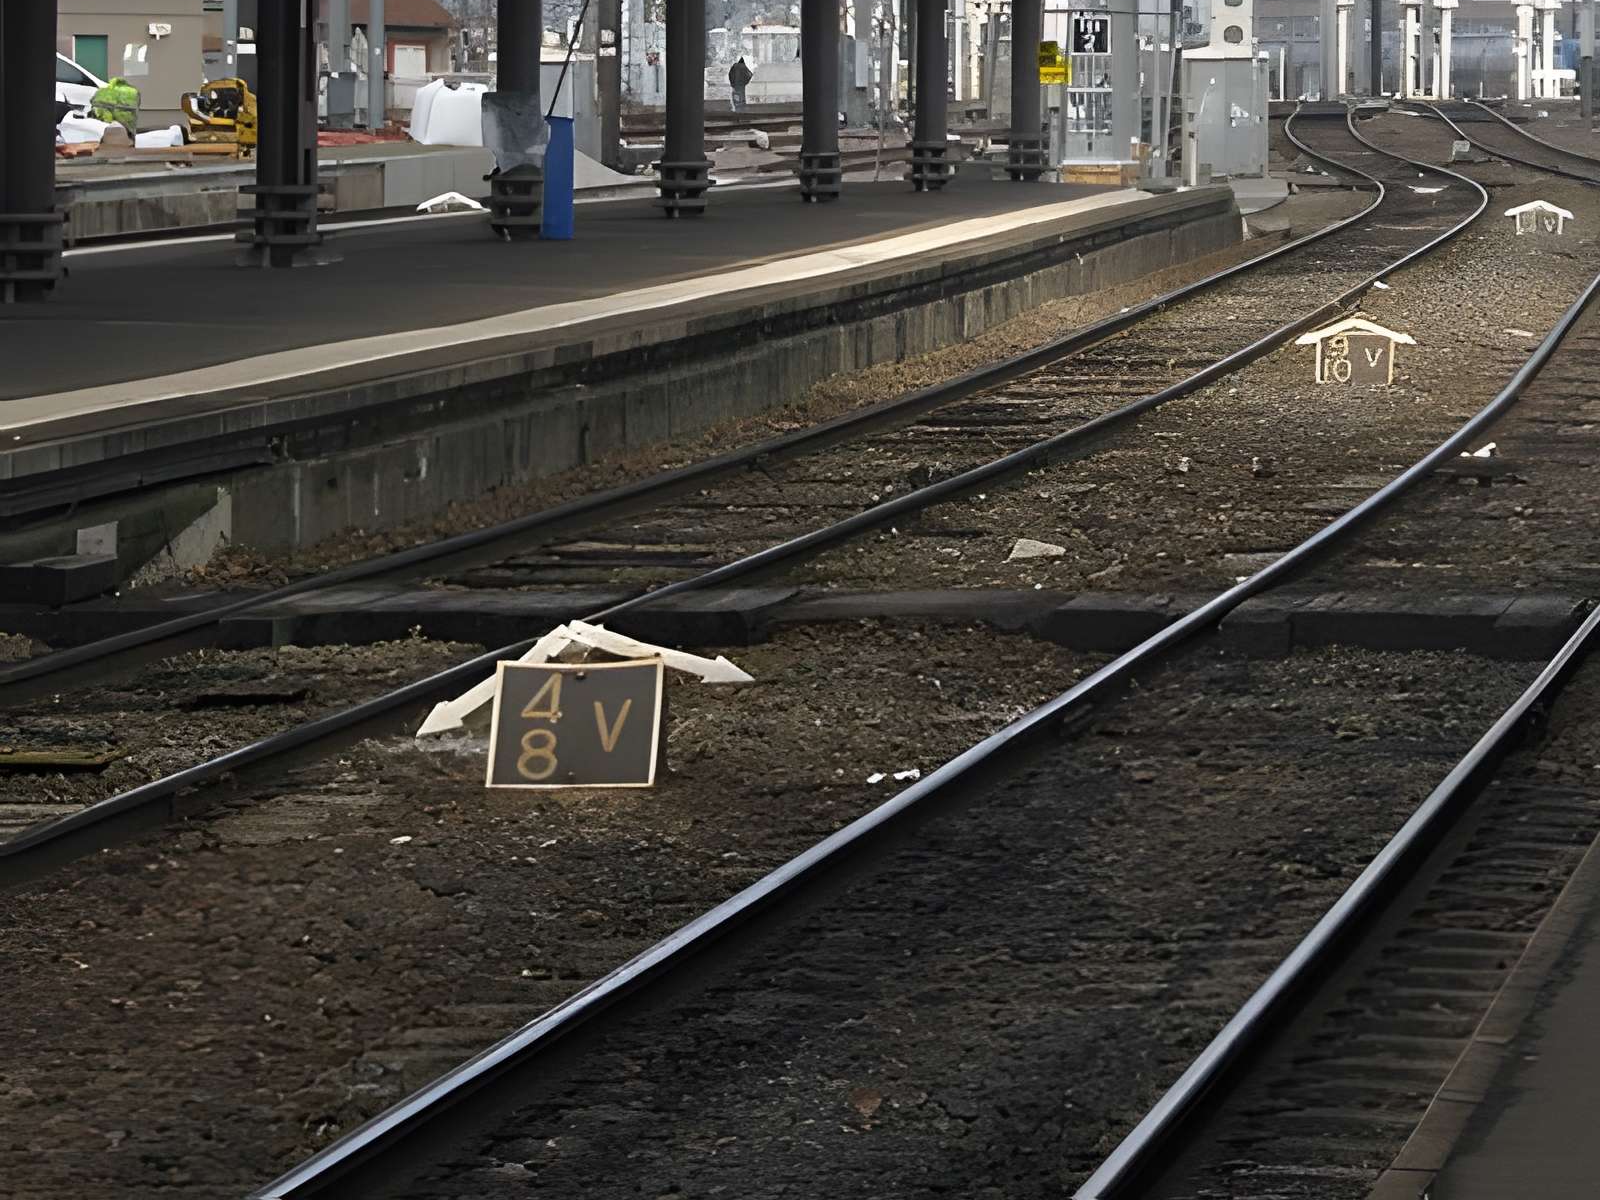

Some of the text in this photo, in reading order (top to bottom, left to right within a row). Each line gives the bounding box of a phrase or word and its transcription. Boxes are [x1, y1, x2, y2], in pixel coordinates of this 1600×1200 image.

[1364, 347, 1384, 368] V
[520, 671, 563, 724] 4
[593, 698, 632, 753] V
[516, 727, 559, 781] 8
